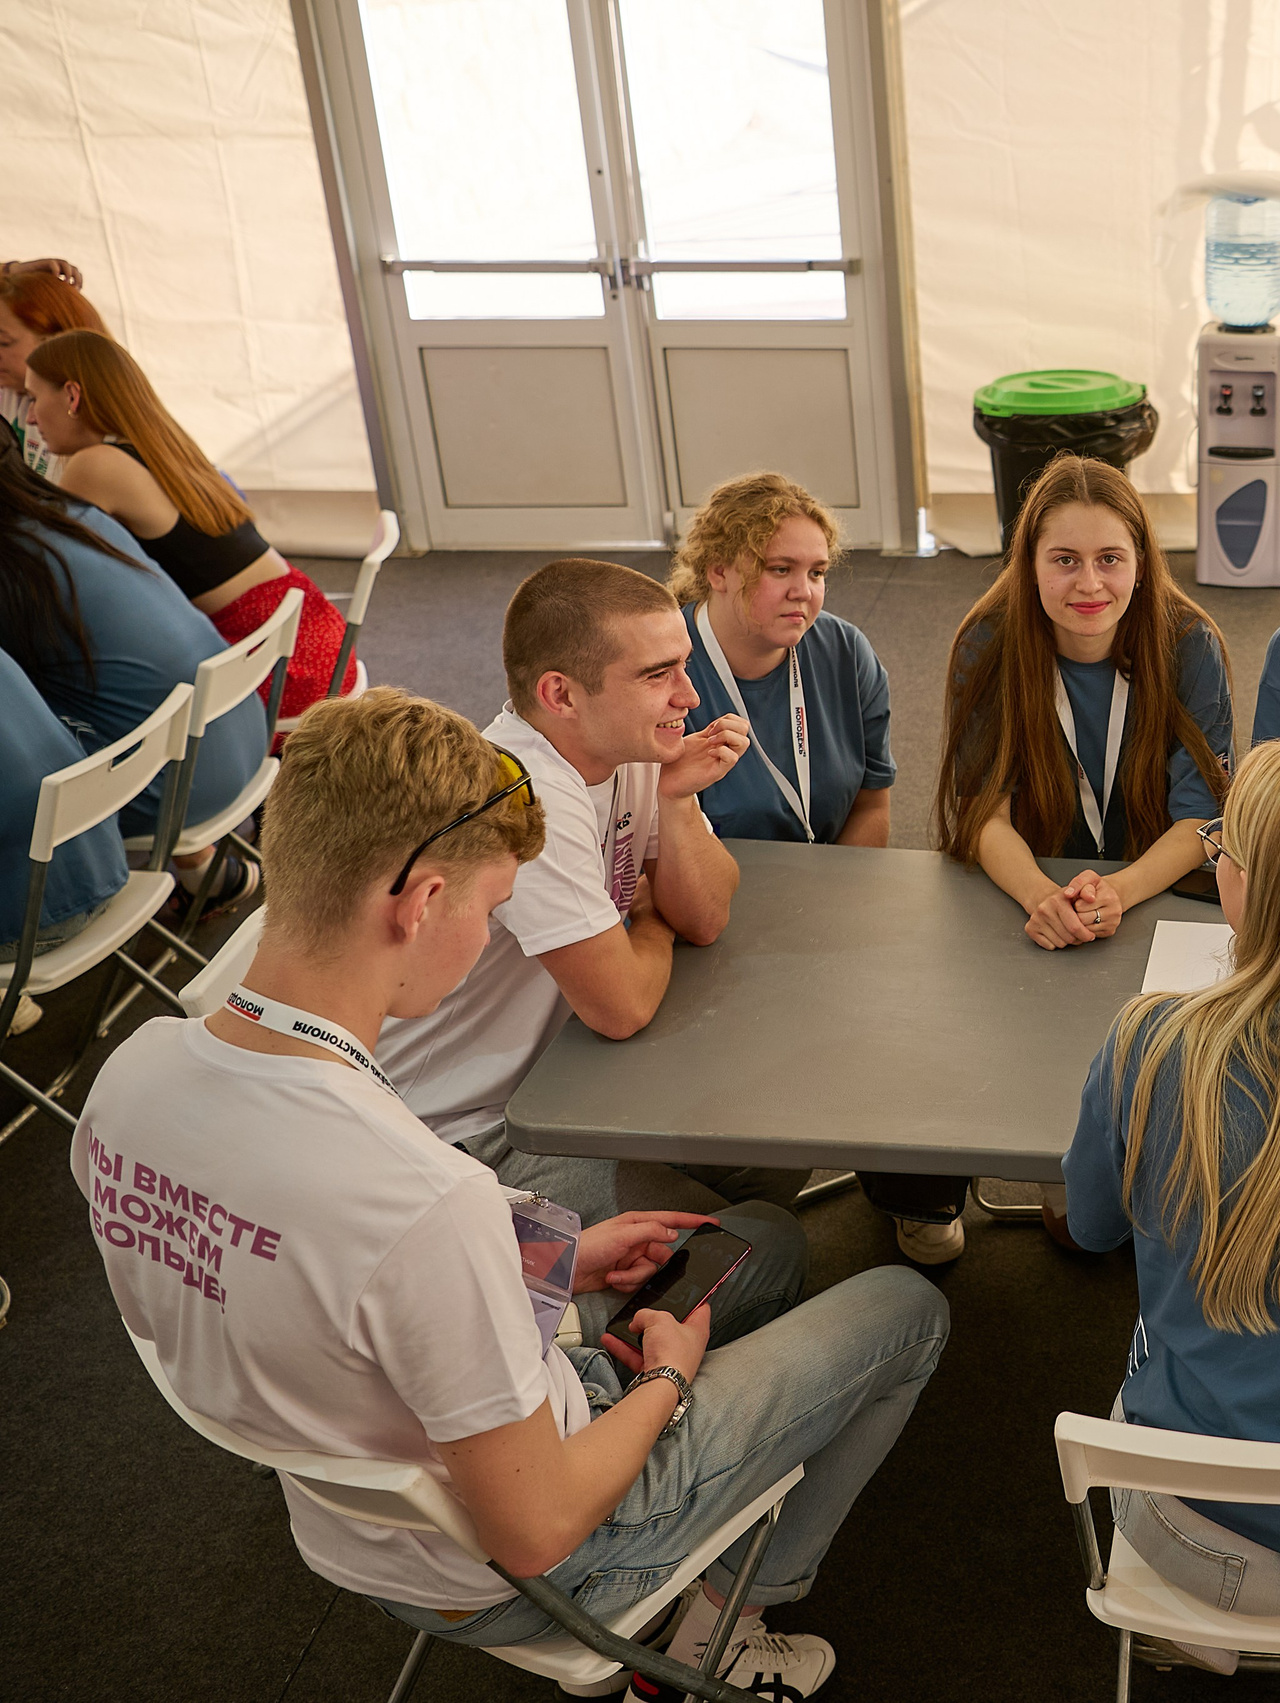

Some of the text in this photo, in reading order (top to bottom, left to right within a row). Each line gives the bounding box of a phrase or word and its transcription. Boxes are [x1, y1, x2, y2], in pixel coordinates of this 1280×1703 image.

[292, 1020, 370, 1069] СЕВАСТОПОЛЯ
[88, 1126, 282, 1262] МЫ ВМЕСТЕ
[94, 1175, 223, 1275] МОЖЕМ
